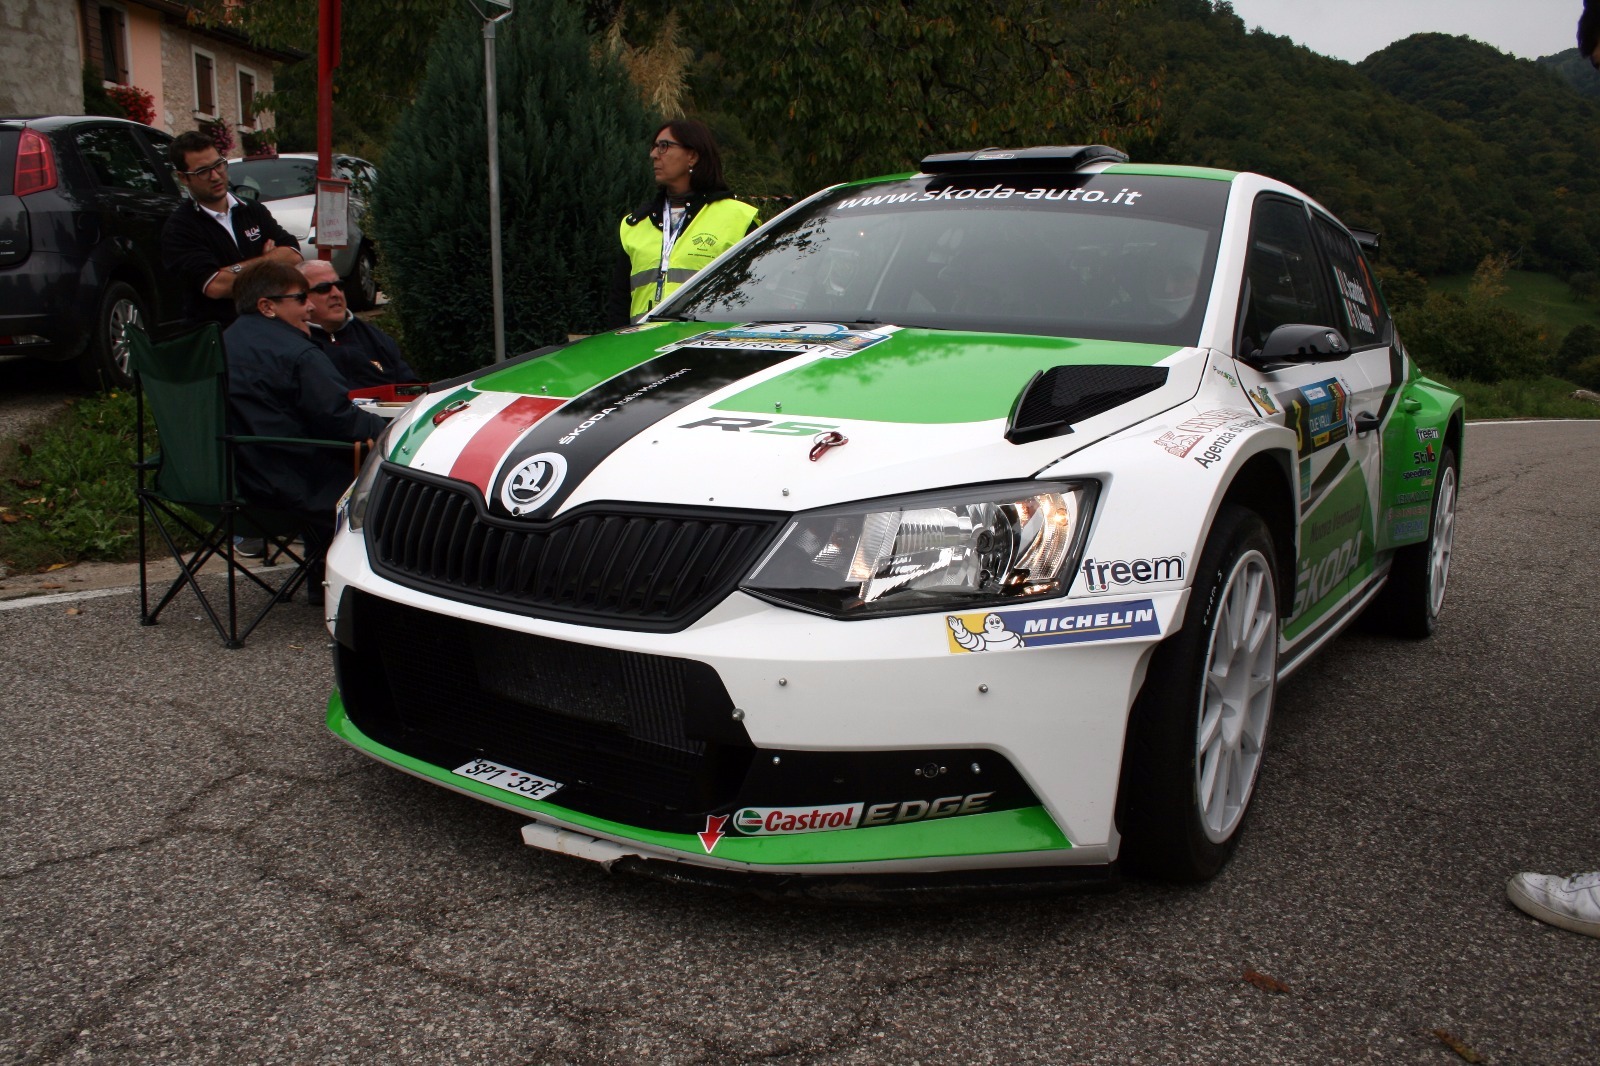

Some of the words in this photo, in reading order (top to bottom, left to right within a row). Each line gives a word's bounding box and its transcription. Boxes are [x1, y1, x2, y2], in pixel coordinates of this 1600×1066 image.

[836, 183, 1143, 210] www.skoda-auto.it
[558, 406, 618, 445] ŠKODA
[678, 416, 841, 437] R5
[1415, 427, 1440, 442] freem
[1194, 431, 1237, 470] Agenzia
[1082, 556, 1182, 585] freem
[1292, 531, 1362, 619] ŠKODA
[1023, 608, 1153, 634] MICHELIN
[764, 806, 854, 832] Castrol
[862, 791, 997, 826] EDGE
